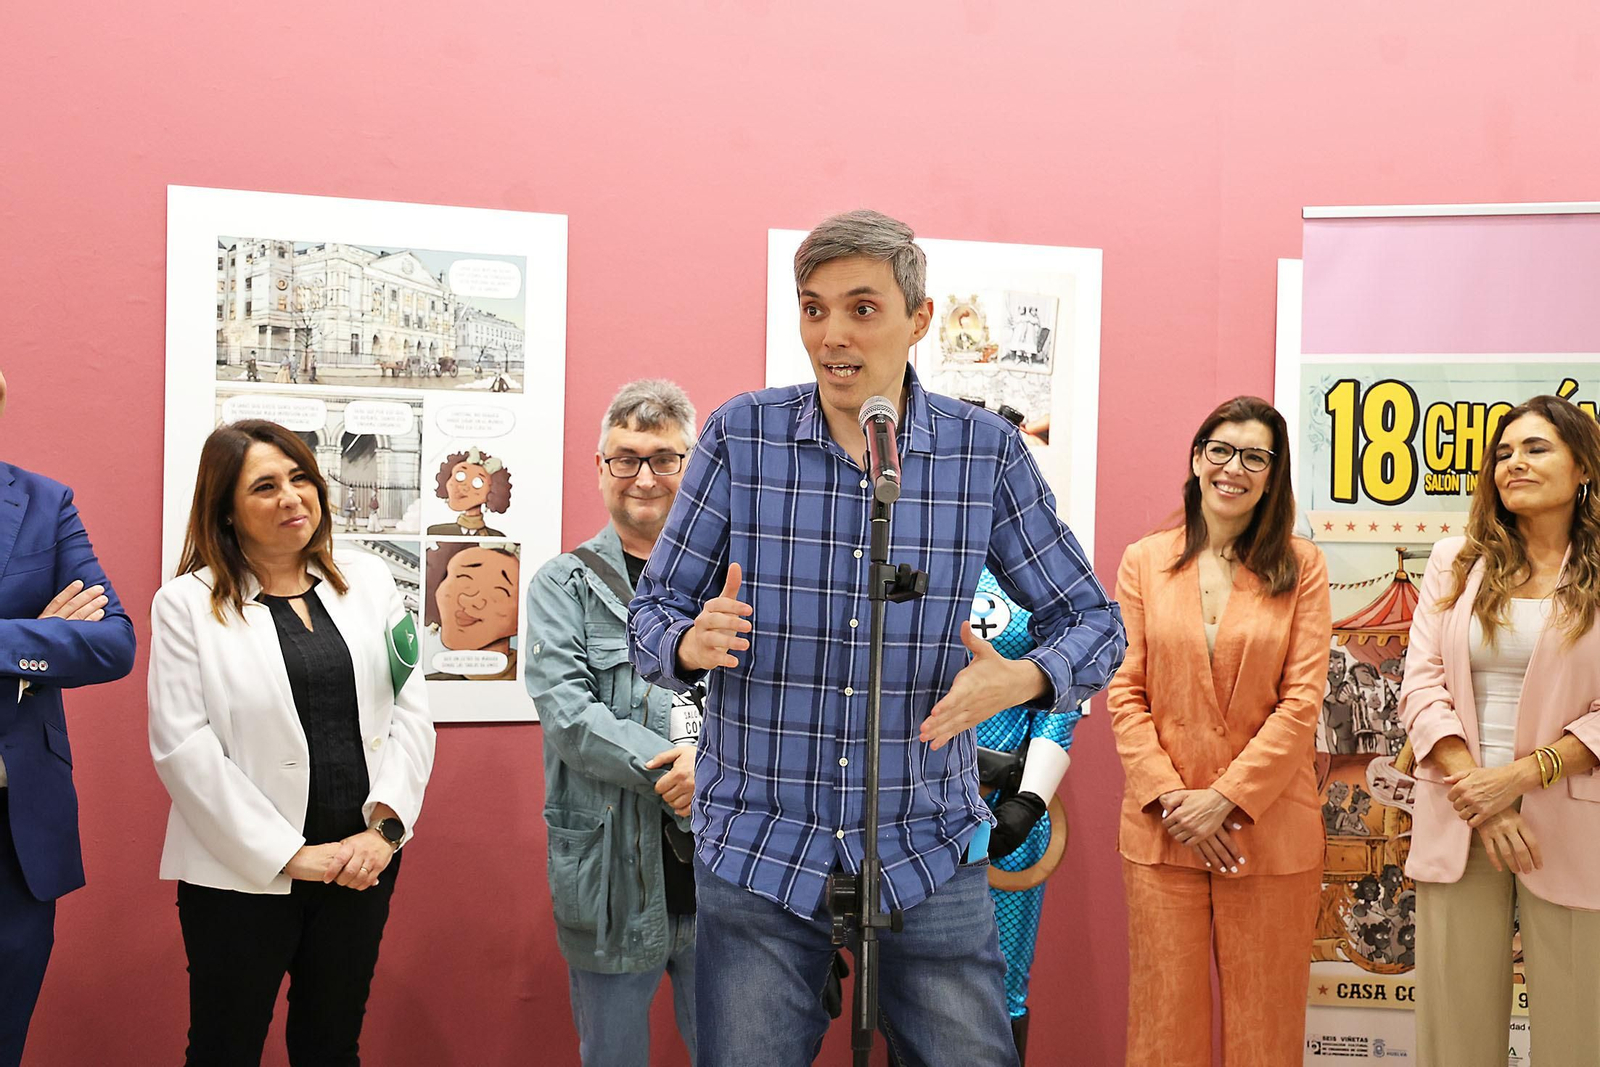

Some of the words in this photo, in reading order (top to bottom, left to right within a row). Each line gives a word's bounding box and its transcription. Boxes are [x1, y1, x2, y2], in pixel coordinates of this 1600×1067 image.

[1325, 379, 1420, 505] 18
[1424, 468, 1460, 495] SALÓN
[685, 721, 702, 735] CO
[1337, 983, 1387, 1000] CASA
